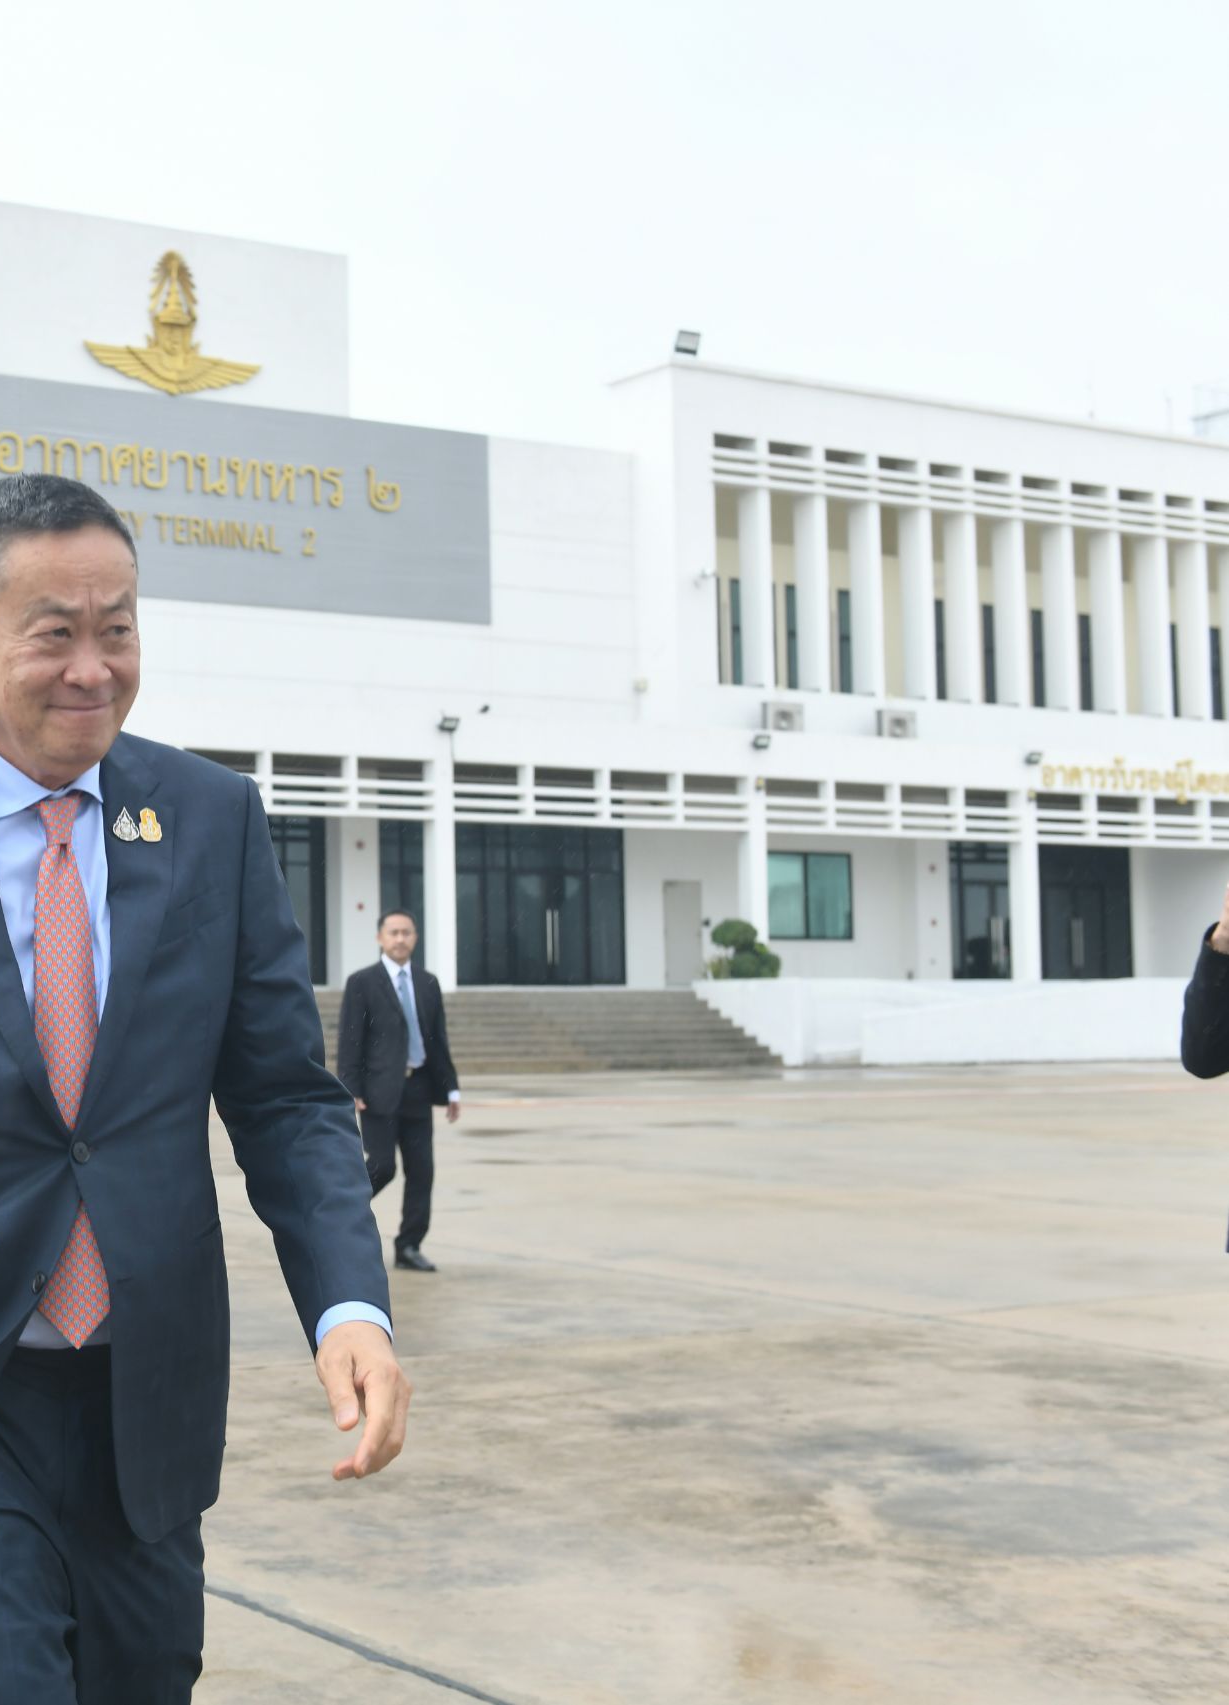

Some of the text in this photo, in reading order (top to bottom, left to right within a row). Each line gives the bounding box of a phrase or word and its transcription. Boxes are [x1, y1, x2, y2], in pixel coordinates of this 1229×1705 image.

[365, 464, 402, 513] ๒
[155, 513, 282, 554] TERMINAL
[301, 527, 317, 557] 2
